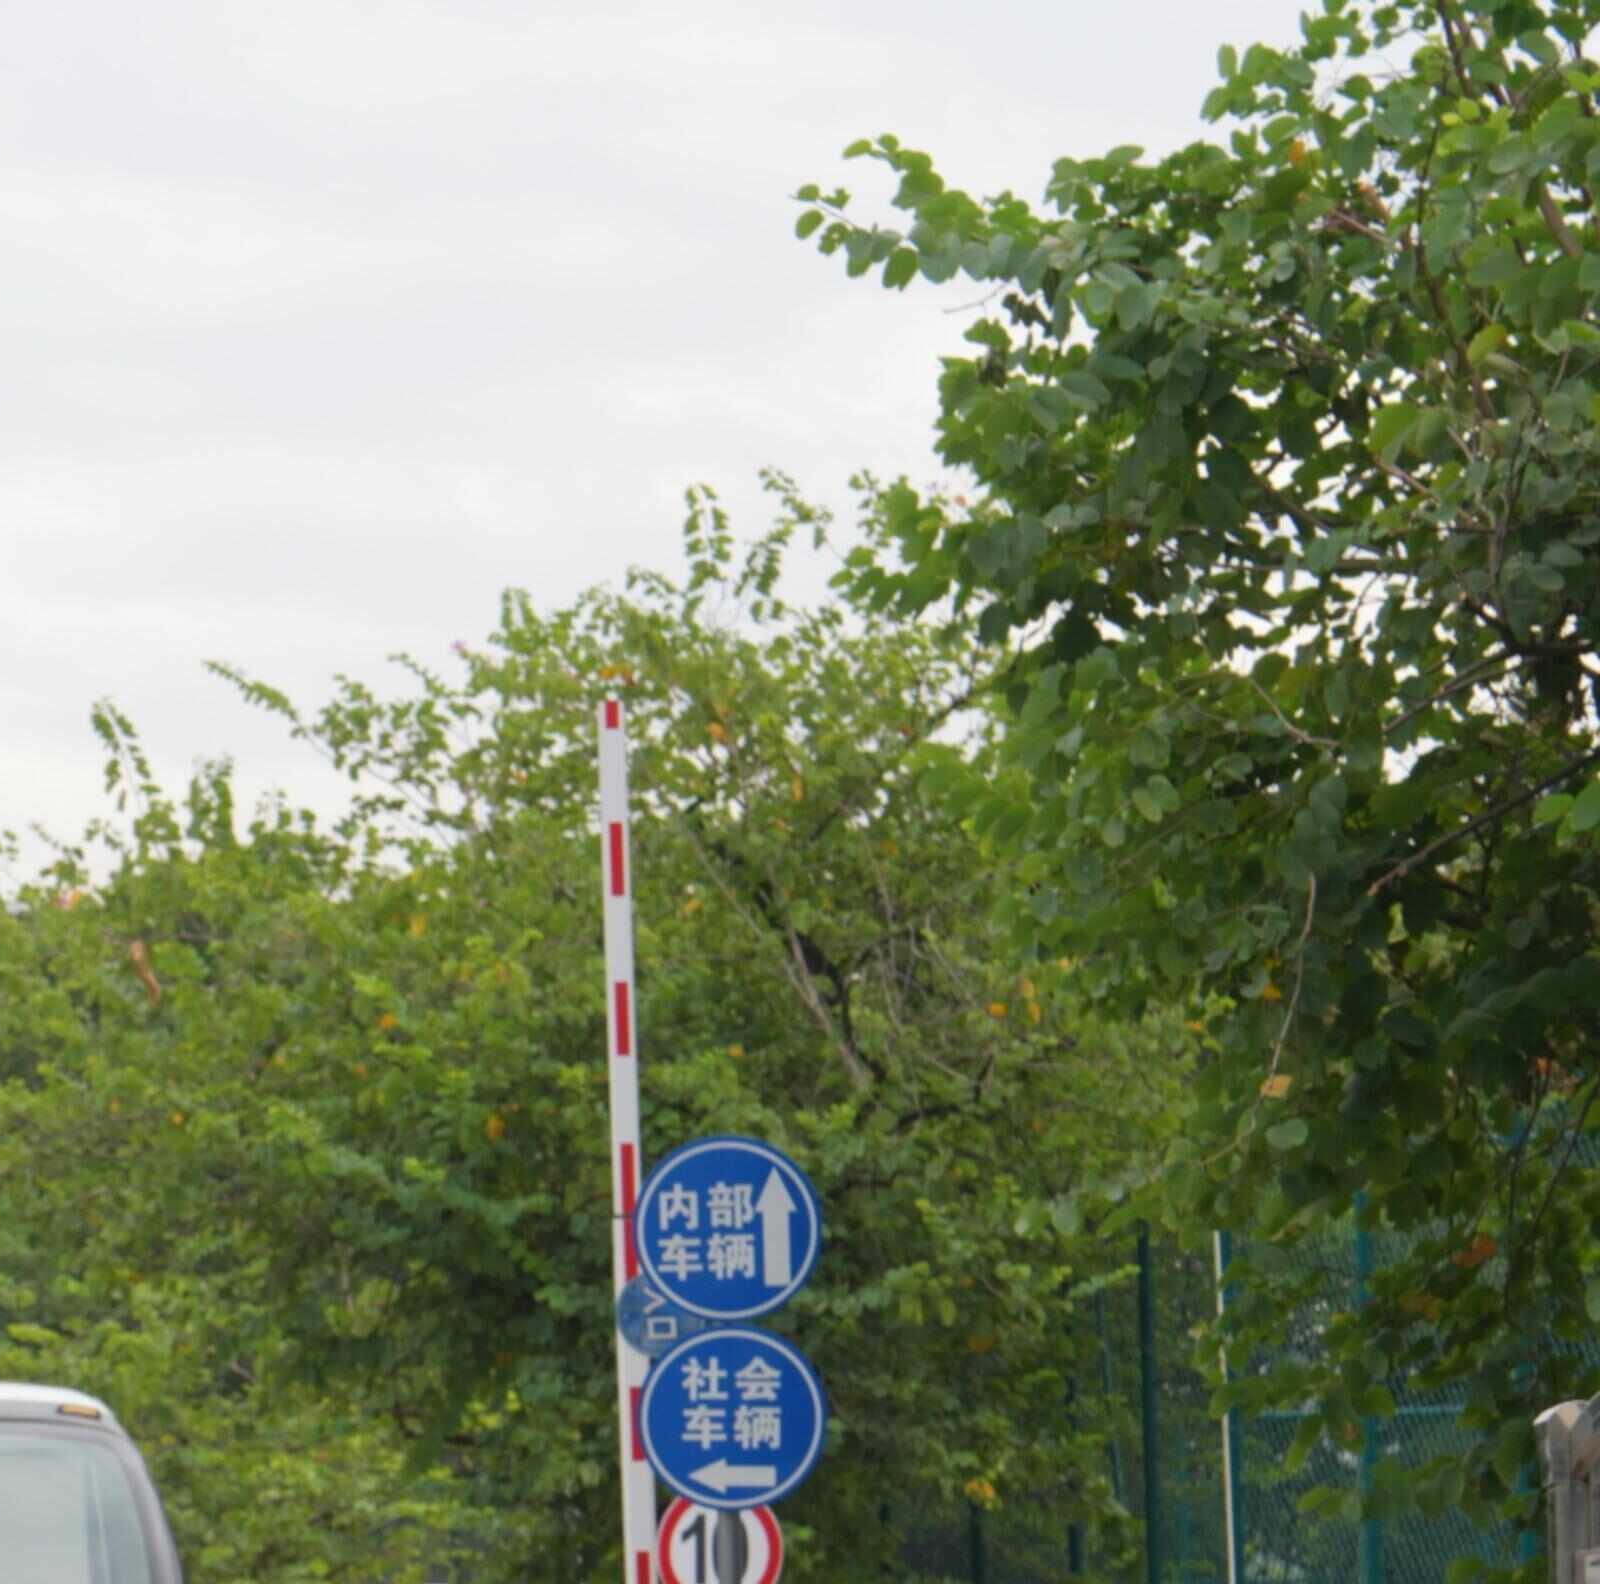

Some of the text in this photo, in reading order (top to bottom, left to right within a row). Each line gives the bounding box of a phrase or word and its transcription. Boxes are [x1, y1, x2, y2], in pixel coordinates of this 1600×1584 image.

[657, 1183, 754, 1230] 内部
[657, 1233, 756, 1281] 车辆
[681, 1357, 782, 1401] 社会
[681, 1405, 782, 1450] 车辆
